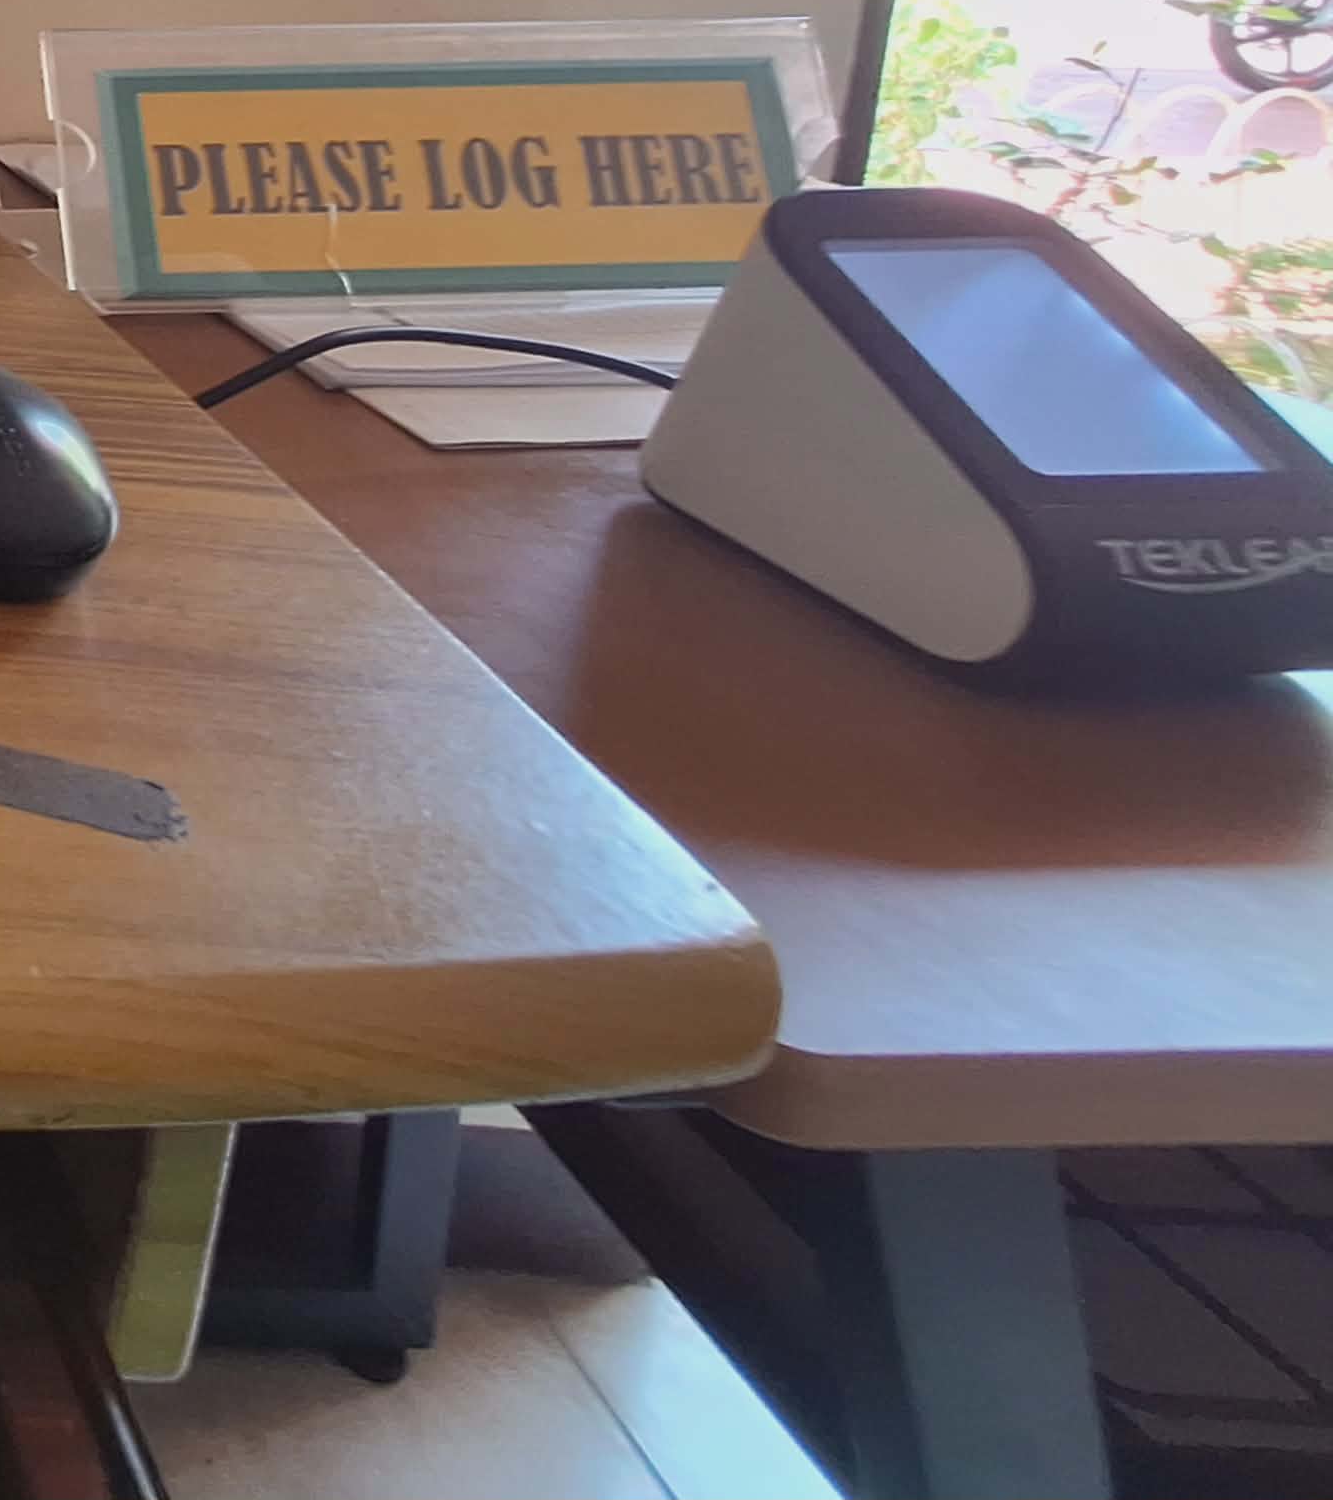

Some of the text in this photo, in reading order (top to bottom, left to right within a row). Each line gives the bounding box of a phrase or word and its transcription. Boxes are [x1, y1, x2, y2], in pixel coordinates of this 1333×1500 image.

[153, 131, 763, 217] PLEASE LOG HERE
